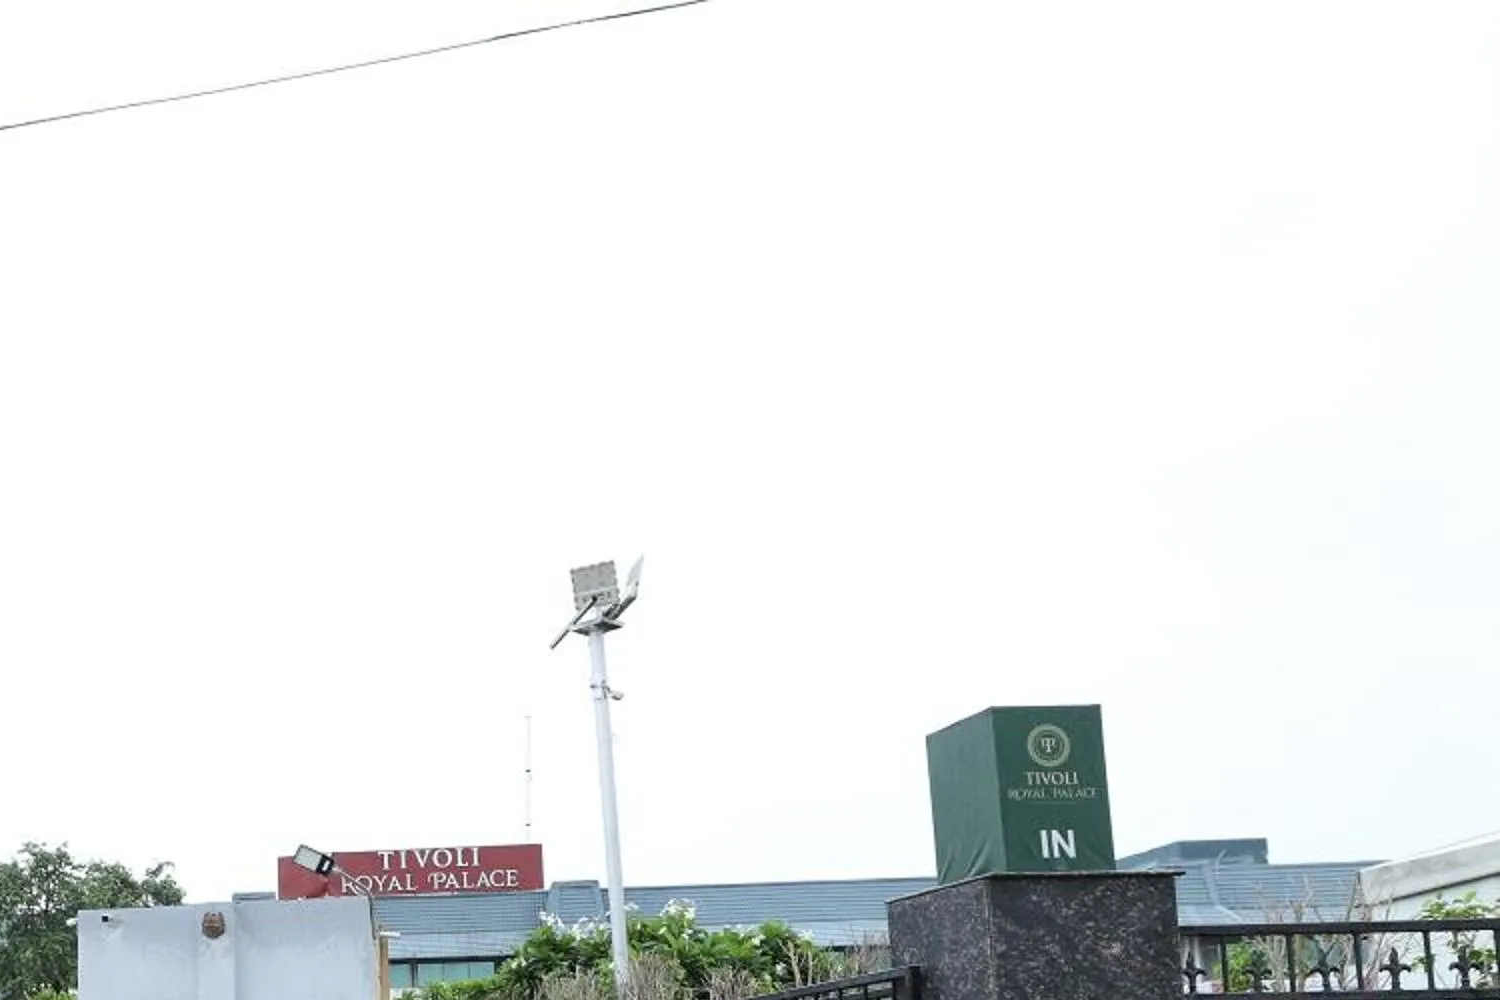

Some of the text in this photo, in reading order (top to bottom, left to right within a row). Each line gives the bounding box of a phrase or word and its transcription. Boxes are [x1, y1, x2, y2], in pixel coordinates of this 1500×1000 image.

[1024, 771, 1078, 785] TIVOLI
[1040, 829, 1077, 859] IN
[377, 847, 480, 870] TIVOLI
[341, 869, 519, 895] ROYAL PALACE
